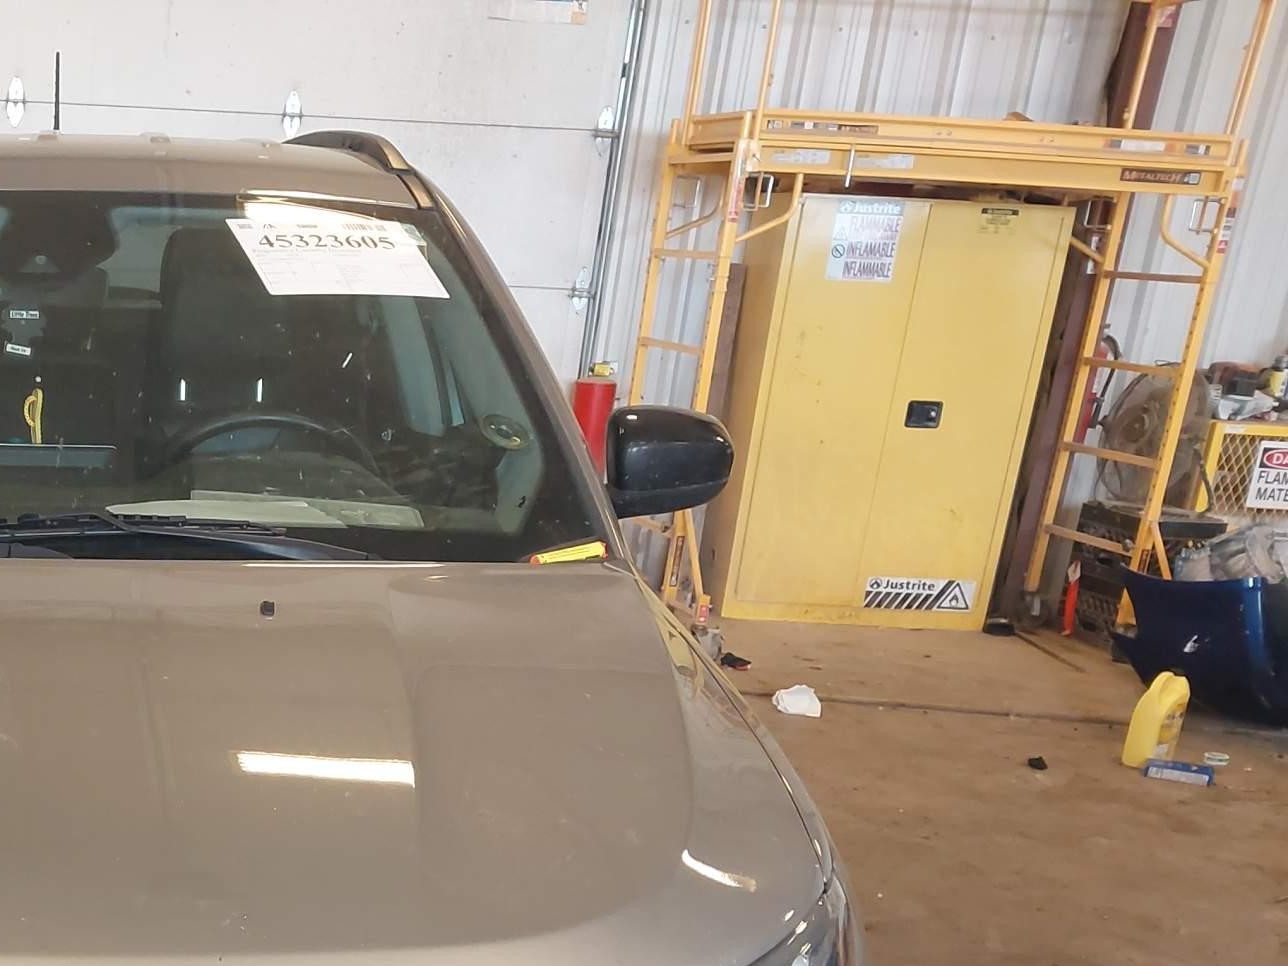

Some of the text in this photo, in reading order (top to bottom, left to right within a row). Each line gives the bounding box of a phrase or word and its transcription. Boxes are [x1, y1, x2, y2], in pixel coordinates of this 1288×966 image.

[258, 234, 396, 250] 45323605
[846, 241, 896, 258] INFLAMABLE
[843, 261, 892, 278] INFLAMMABLE
[1255, 487, 1288, 502] MATE
[883, 580, 935, 591] Justrite
